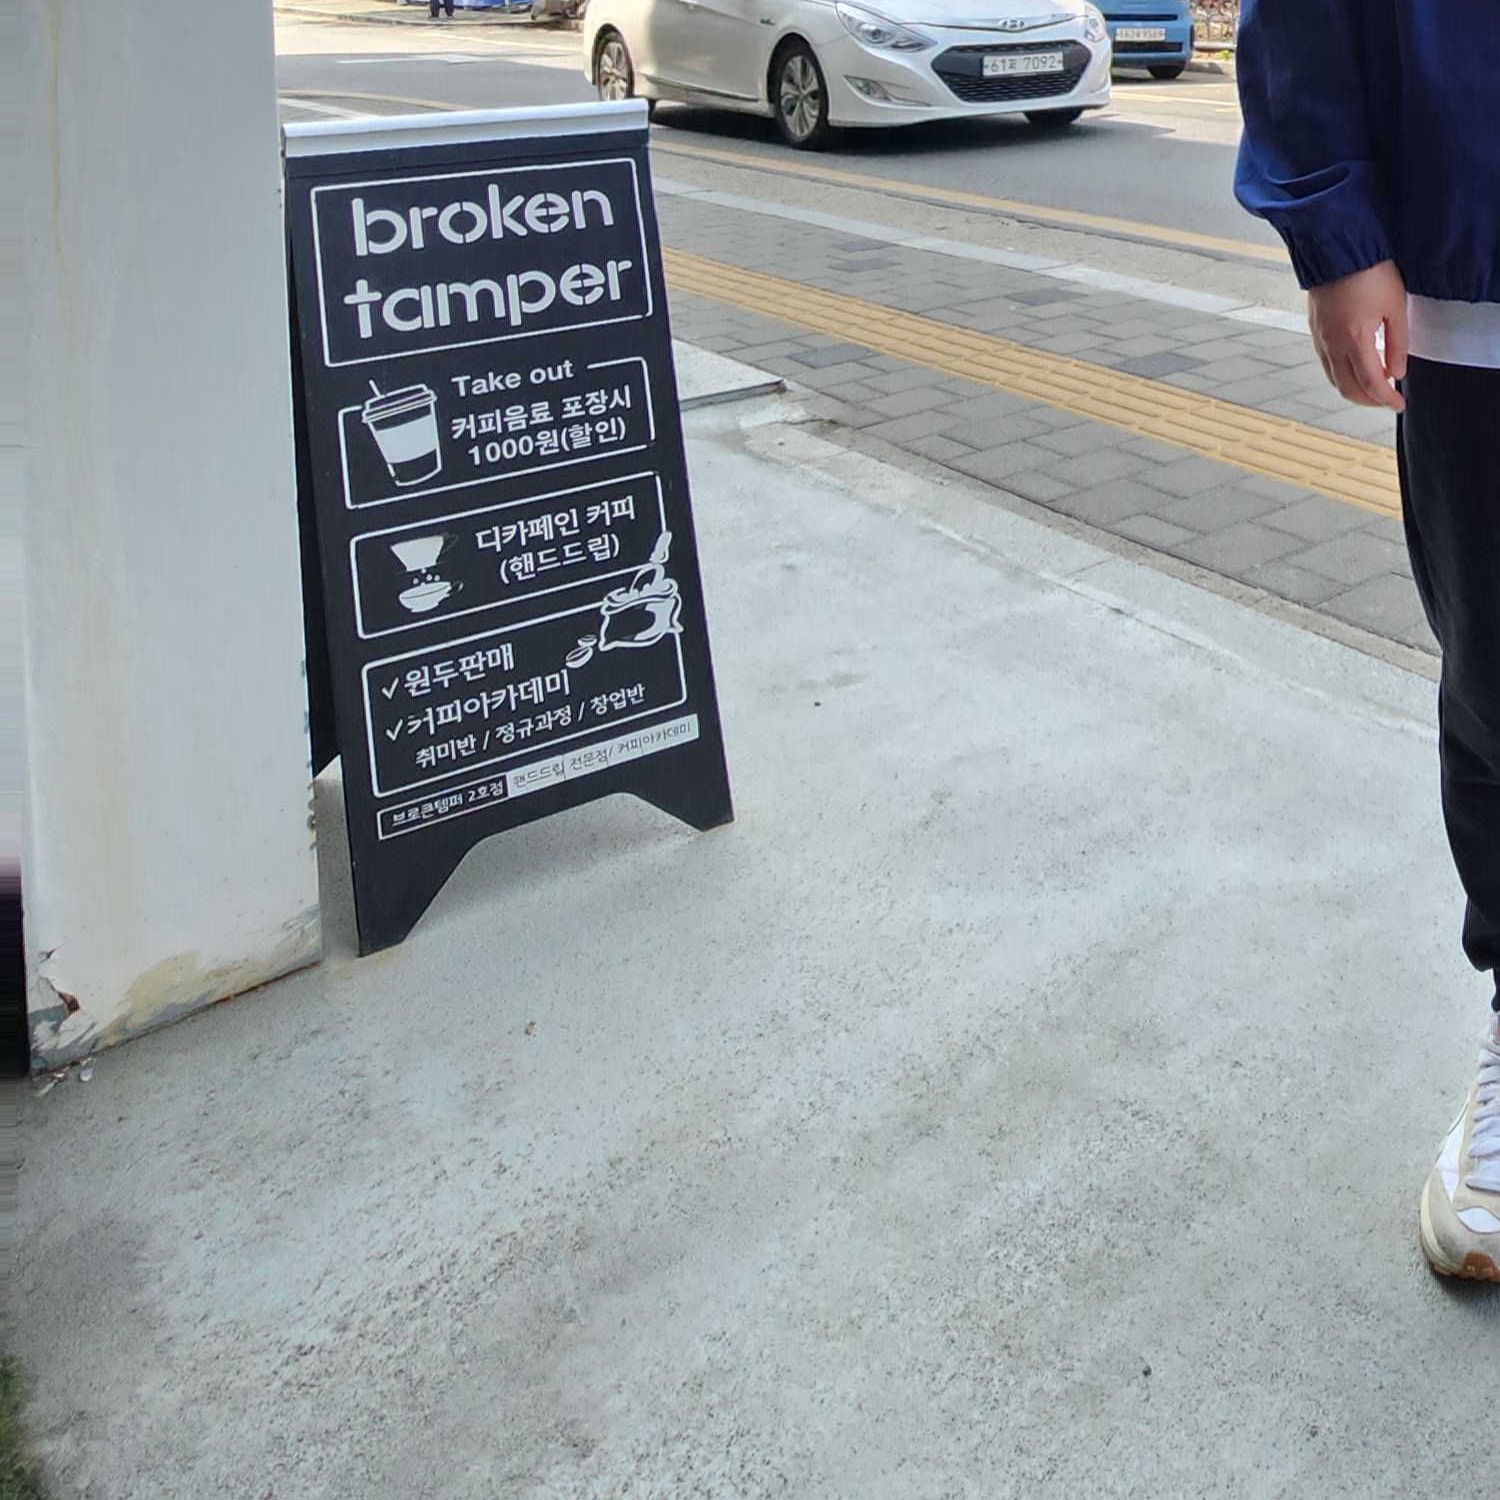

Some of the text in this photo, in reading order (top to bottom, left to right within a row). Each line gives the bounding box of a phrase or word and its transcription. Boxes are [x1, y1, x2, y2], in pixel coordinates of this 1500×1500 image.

[1023, 55, 1056, 70] 7092
[351, 183, 614, 256] broken
[343, 259, 632, 339] tamper
[451, 359, 574, 397] Take out
[451, 384, 632, 440] 커피음료 포장시
[467, 416, 626, 466] 1000원(할인)
[475, 495, 635, 552] 디카페인 커피
[499, 533, 620, 584] (핸드드립)
[403, 642, 515, 697] 원두판매
[407, 668, 570, 736] 커피아카데미
[415, 734, 477, 768] 취미반
[495, 705, 572, 744] 정규과정
[590, 683, 646, 716] 창업반
[468, 780, 503, 803] 2호점
[513, 759, 564, 787] 핸드드립
[618, 721, 691, 753] 커피아카데미
